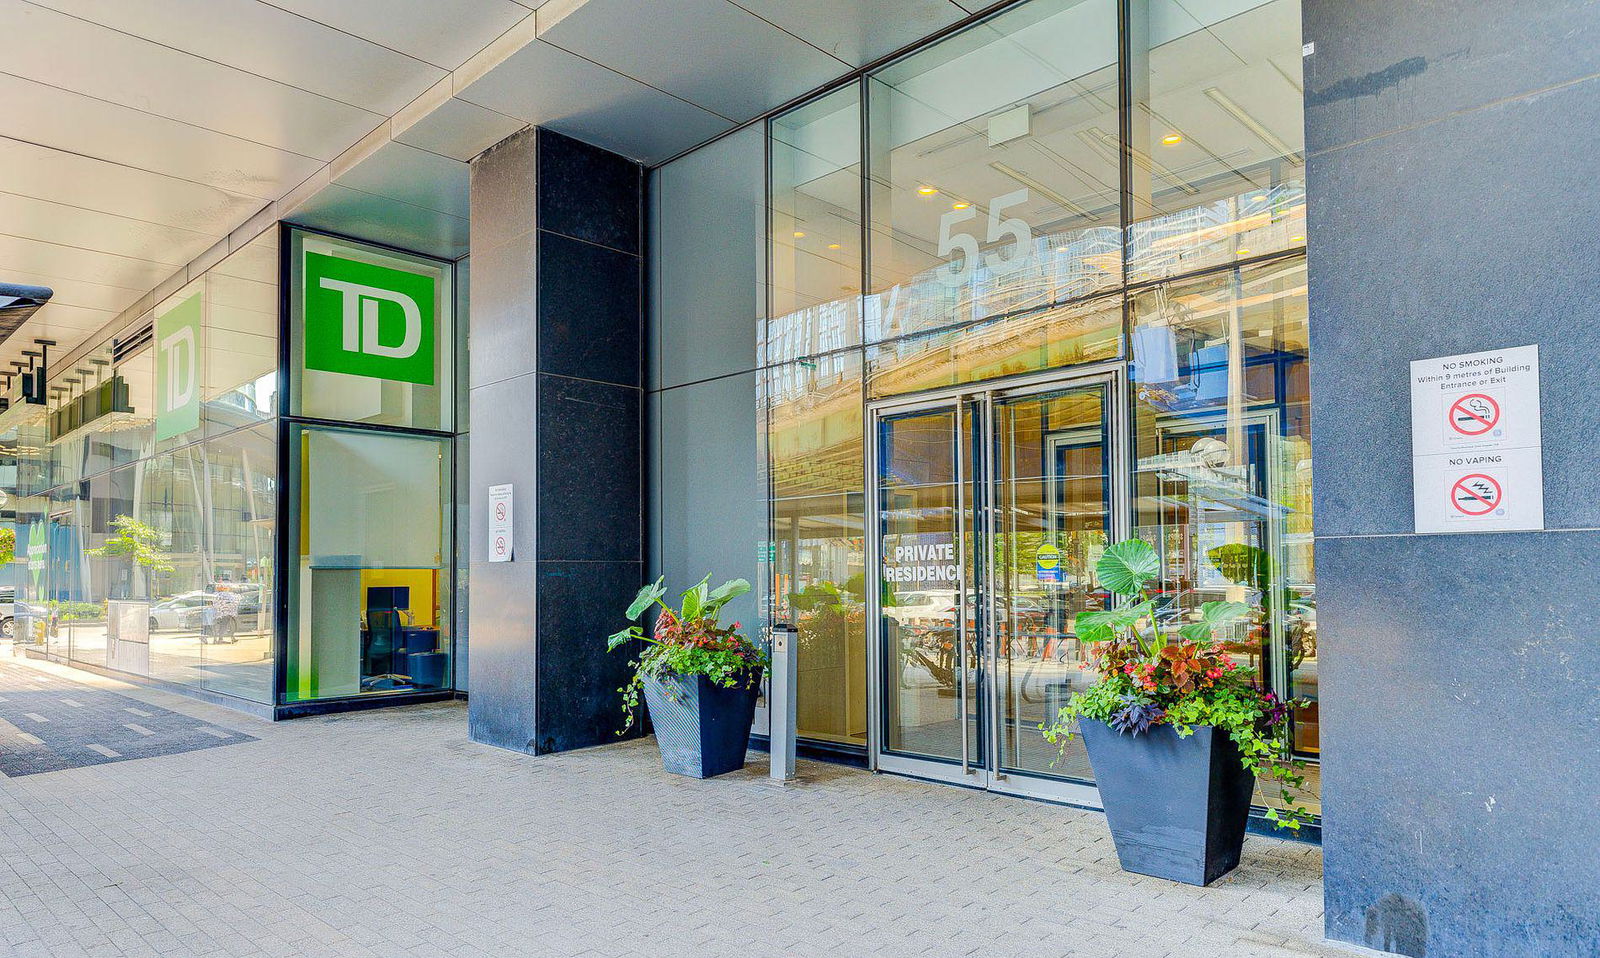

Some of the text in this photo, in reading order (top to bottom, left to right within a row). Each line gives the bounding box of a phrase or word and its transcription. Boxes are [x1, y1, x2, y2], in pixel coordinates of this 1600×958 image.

[936, 188, 1032, 288] 55
[319, 277, 422, 359] TD
[161, 325, 195, 413] TD
[1442, 356, 1504, 371] NO SMOKING
[1418, 364, 1531, 383] Within 9 metres of Building
[1440, 380, 1477, 390] Entrance
[1490, 376, 1506, 384] Exit
[1449, 455, 1502, 466] NO VAPING
[895, 544, 954, 562] PRIVATE
